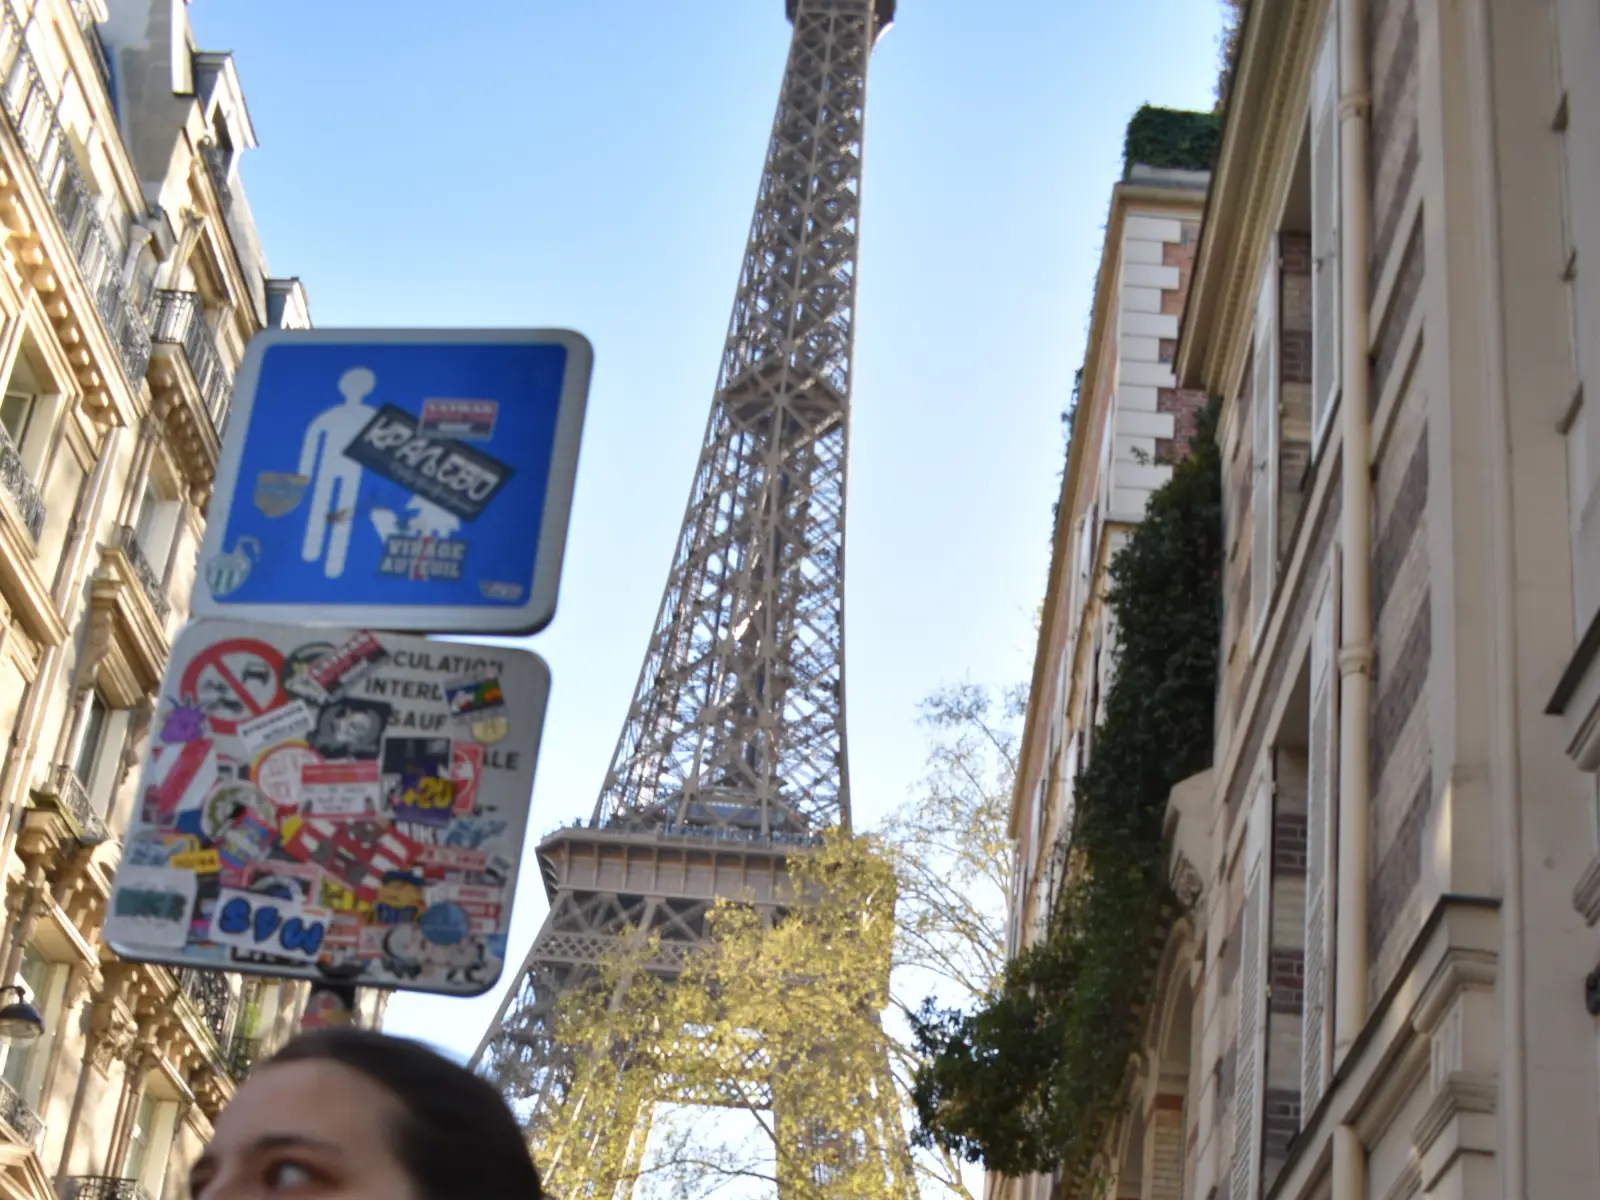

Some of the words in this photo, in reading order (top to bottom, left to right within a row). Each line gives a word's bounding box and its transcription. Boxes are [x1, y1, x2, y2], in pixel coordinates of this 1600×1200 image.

[383, 650, 504, 674] CULATION
[388, 710, 447, 731] SAUF
[484, 750, 521, 770] LE
